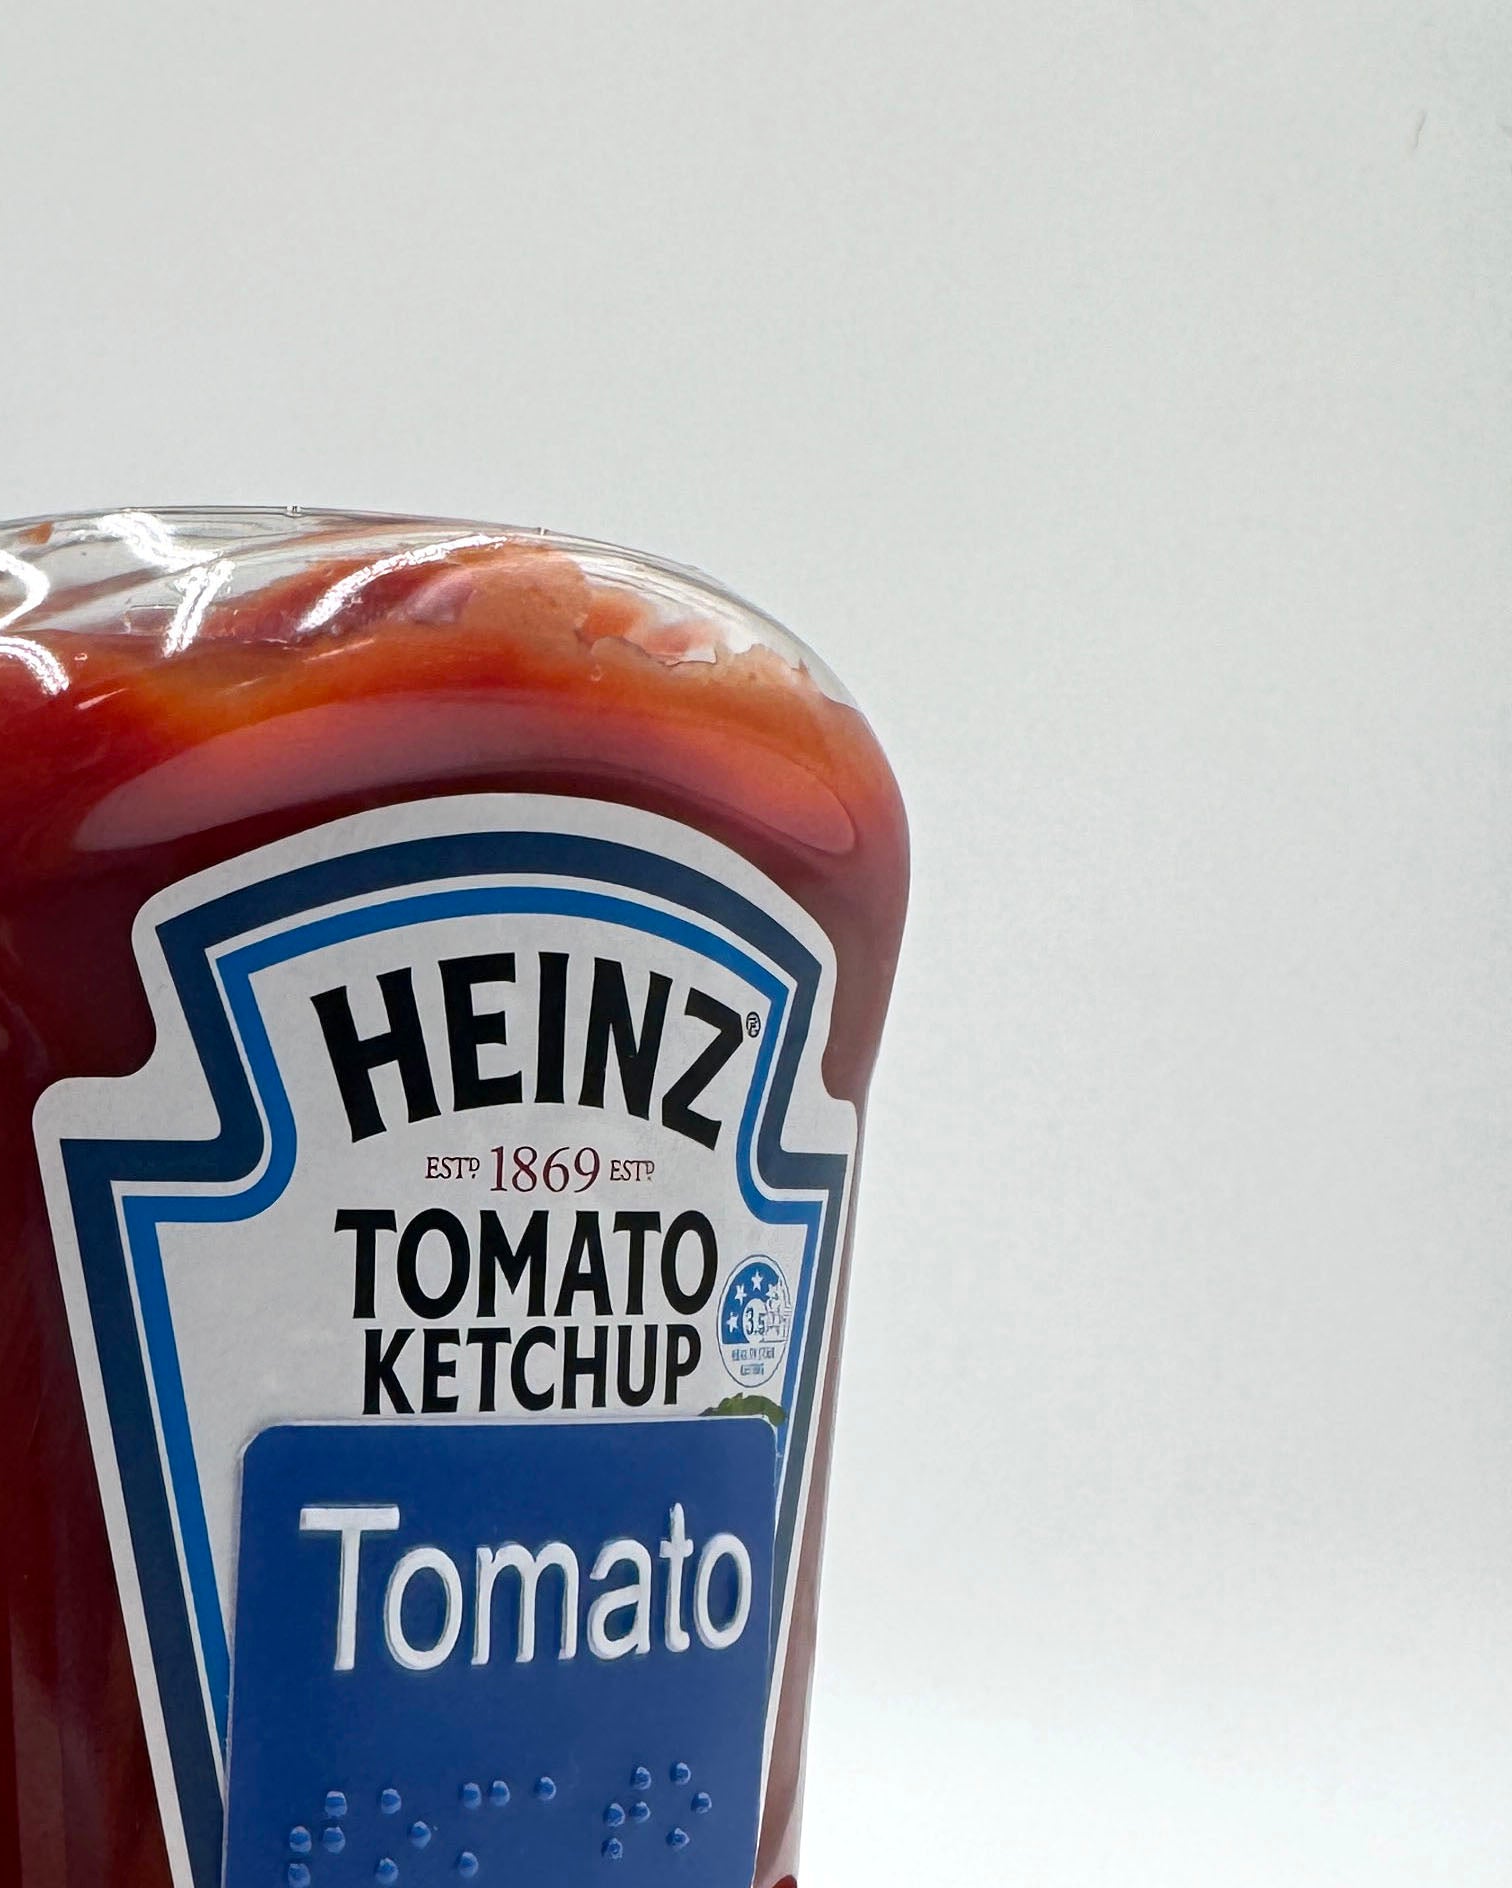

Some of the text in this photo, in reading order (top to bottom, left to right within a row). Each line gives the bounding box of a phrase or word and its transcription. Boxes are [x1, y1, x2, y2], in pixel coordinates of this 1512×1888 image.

[490, 1146, 600, 1193] 1869
[334, 1207, 719, 1320] TOMATO
[362, 1323, 702, 1416] KETCHUP
[299, 1502, 752, 1673] Tomato
